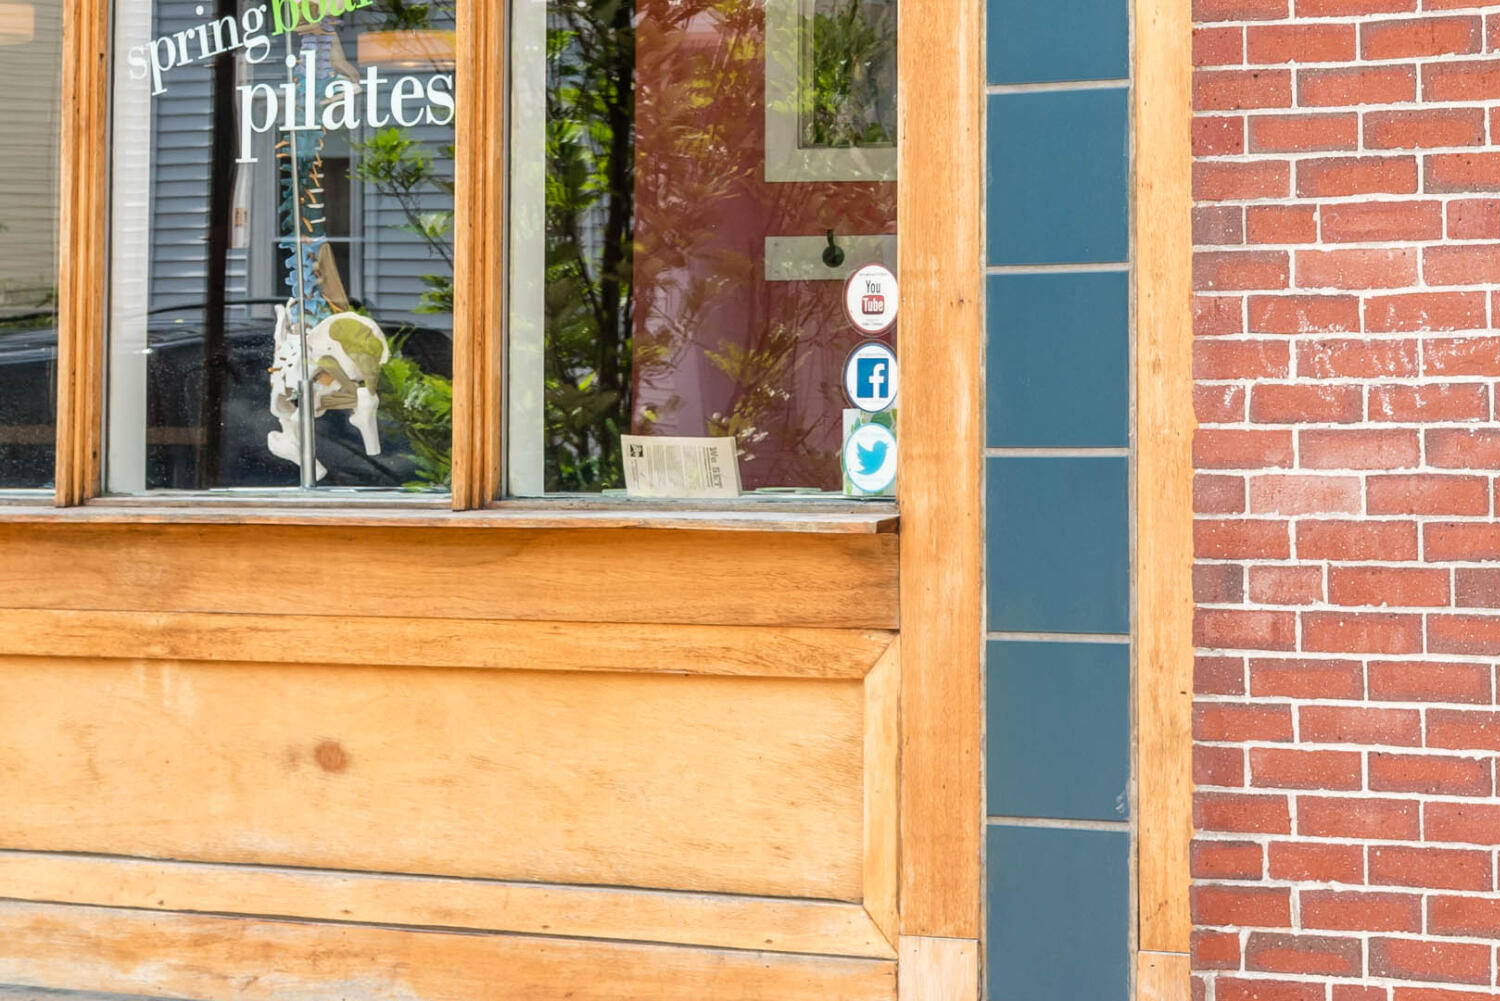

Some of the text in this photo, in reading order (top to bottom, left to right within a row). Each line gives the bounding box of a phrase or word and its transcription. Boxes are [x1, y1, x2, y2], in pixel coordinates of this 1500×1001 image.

[235, 49, 456, 164] pilates
[865, 280, 881, 294] You
[863, 297, 884, 312] Tube
